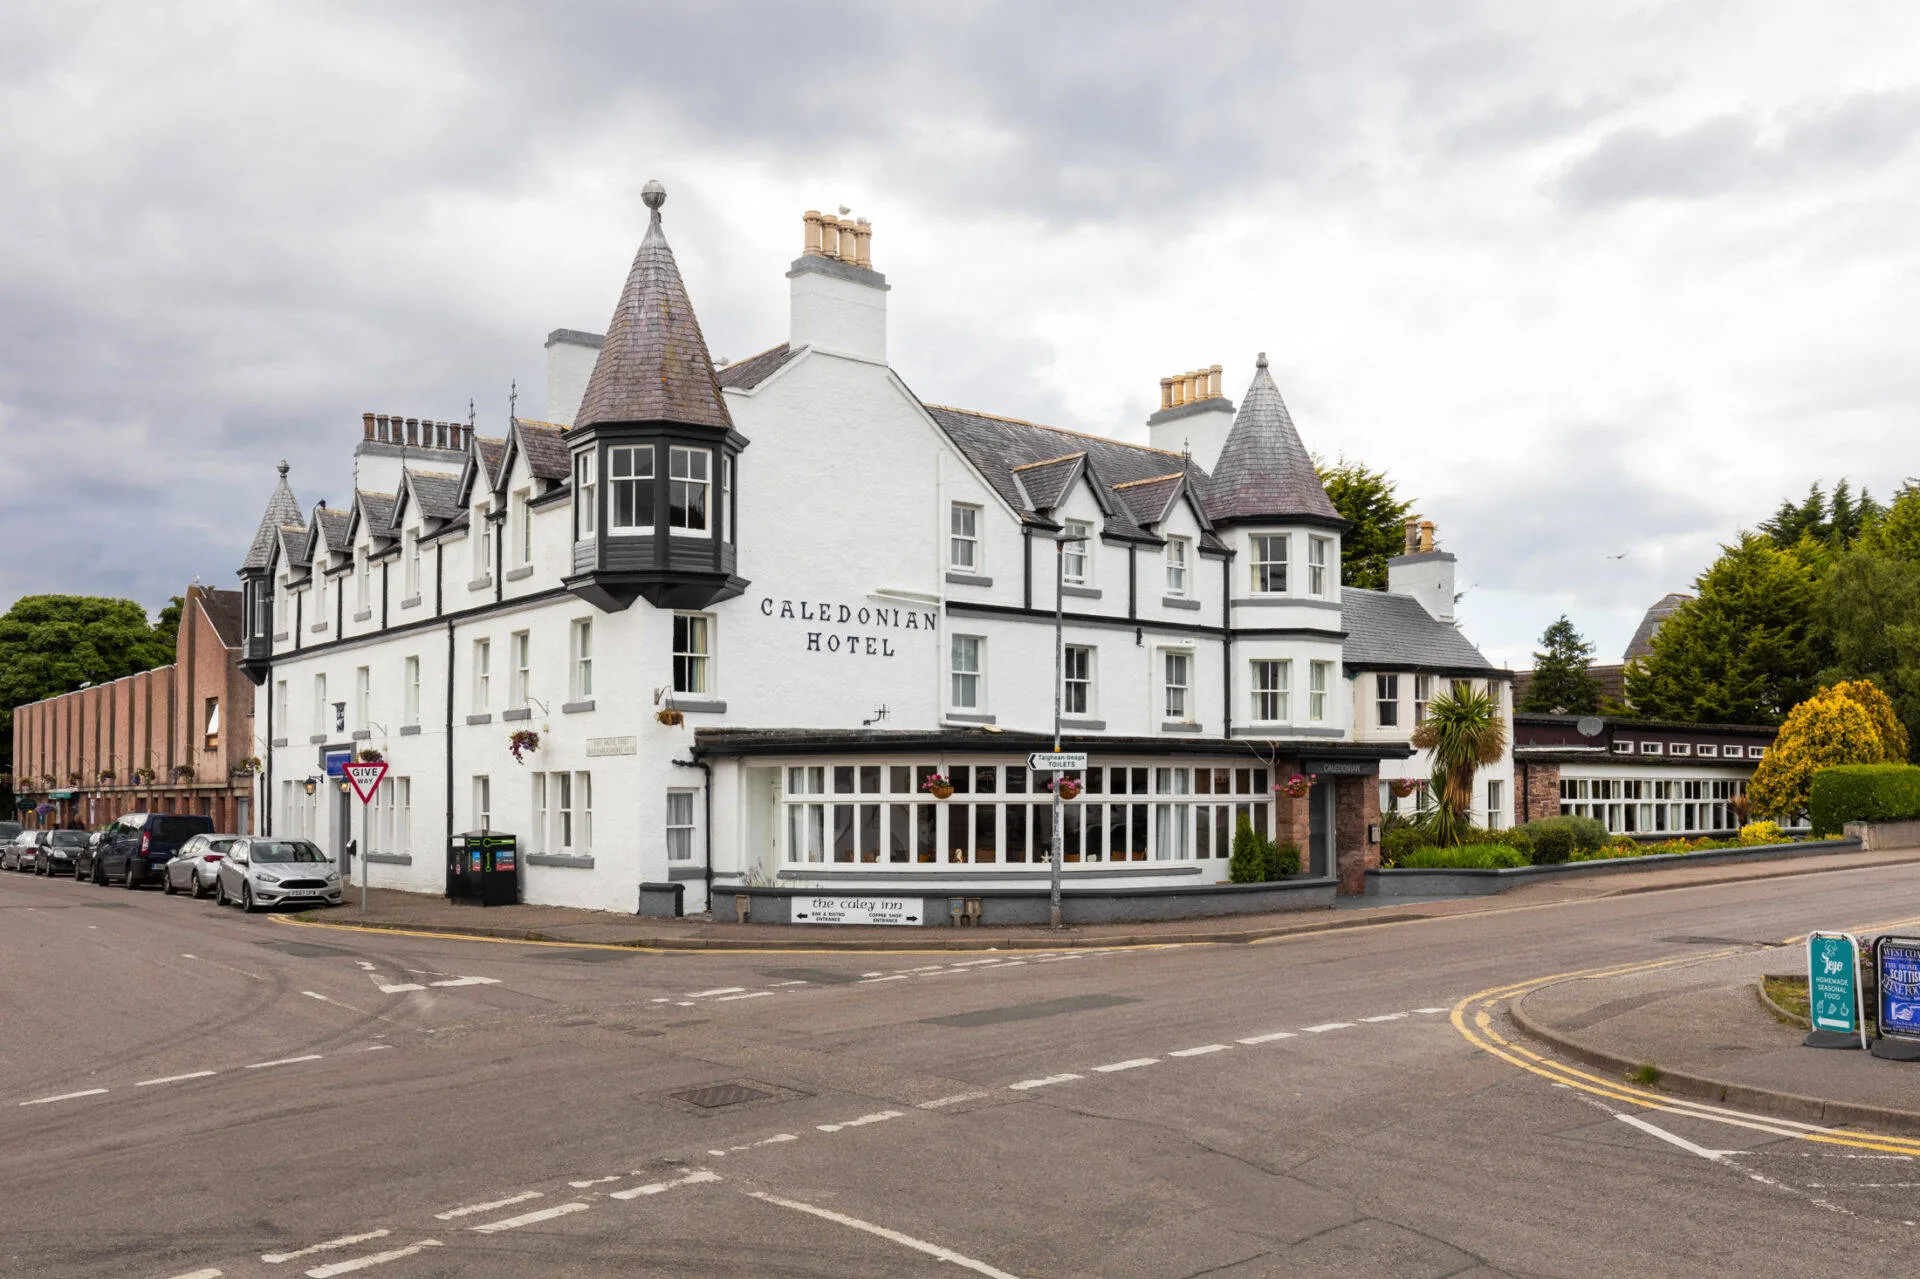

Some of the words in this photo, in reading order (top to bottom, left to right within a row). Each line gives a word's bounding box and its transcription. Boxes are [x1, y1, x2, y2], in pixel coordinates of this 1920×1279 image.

[761, 598, 936, 630] CALEDONIAN
[807, 632, 894, 656] HOTEL
[352, 768, 378, 777] GIVE
[1323, 763, 1361, 773] CALEDONIAN
[812, 899, 834, 909] the
[840, 899, 876, 911] caley
[881, 900, 903, 910] inn
[1883, 947, 1903, 957] WEST
[1816, 976, 1848, 986] HOMEMADE
[1818, 984, 1847, 993] SEASONAL
